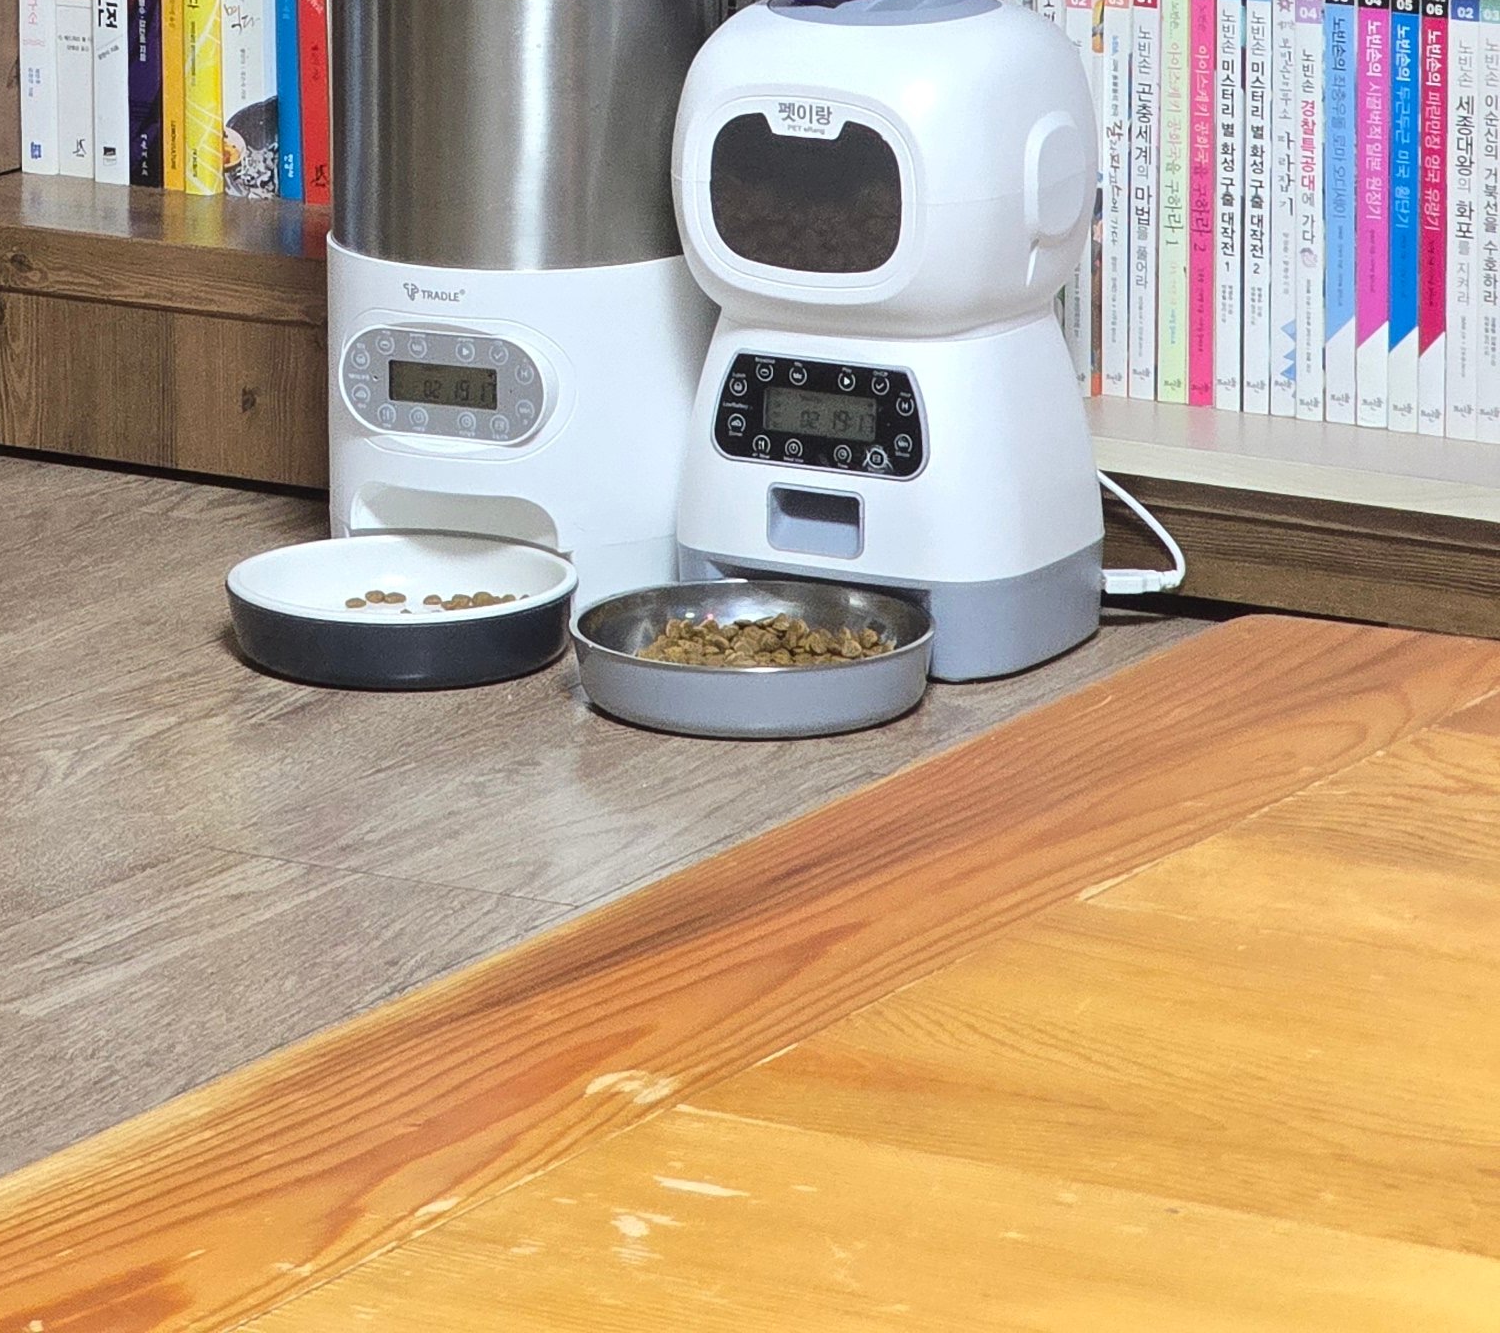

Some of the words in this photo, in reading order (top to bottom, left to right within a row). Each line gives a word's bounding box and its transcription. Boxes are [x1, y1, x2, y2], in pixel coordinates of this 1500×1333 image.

[1138, 26, 1154, 75] 노빈손
[1220, 9, 1236, 55] 노빈손
[1365, 20, 1383, 78] 노빈손의
[1220, 60, 1236, 118] 미스터리
[1301, 49, 1316, 94] 노빈손
[778, 101, 833, 126] 펫이랑
[1135, 83, 1154, 181] 곤충세계의
[1220, 121, 1236, 137] 별
[1220, 139, 1236, 173] 화성
[1301, 99, 1317, 207] 경찰특공대에
[1456, 94, 1475, 197] 세종대왕의
[1220, 177, 1236, 207] 구출
[1135, 187, 1152, 247] 마법을
[1220, 212, 1236, 258] 대작전
[1301, 214, 1316, 245] 가다
[1456, 200, 1475, 256] 화포를
[421, 289, 462, 303] TRADLE
